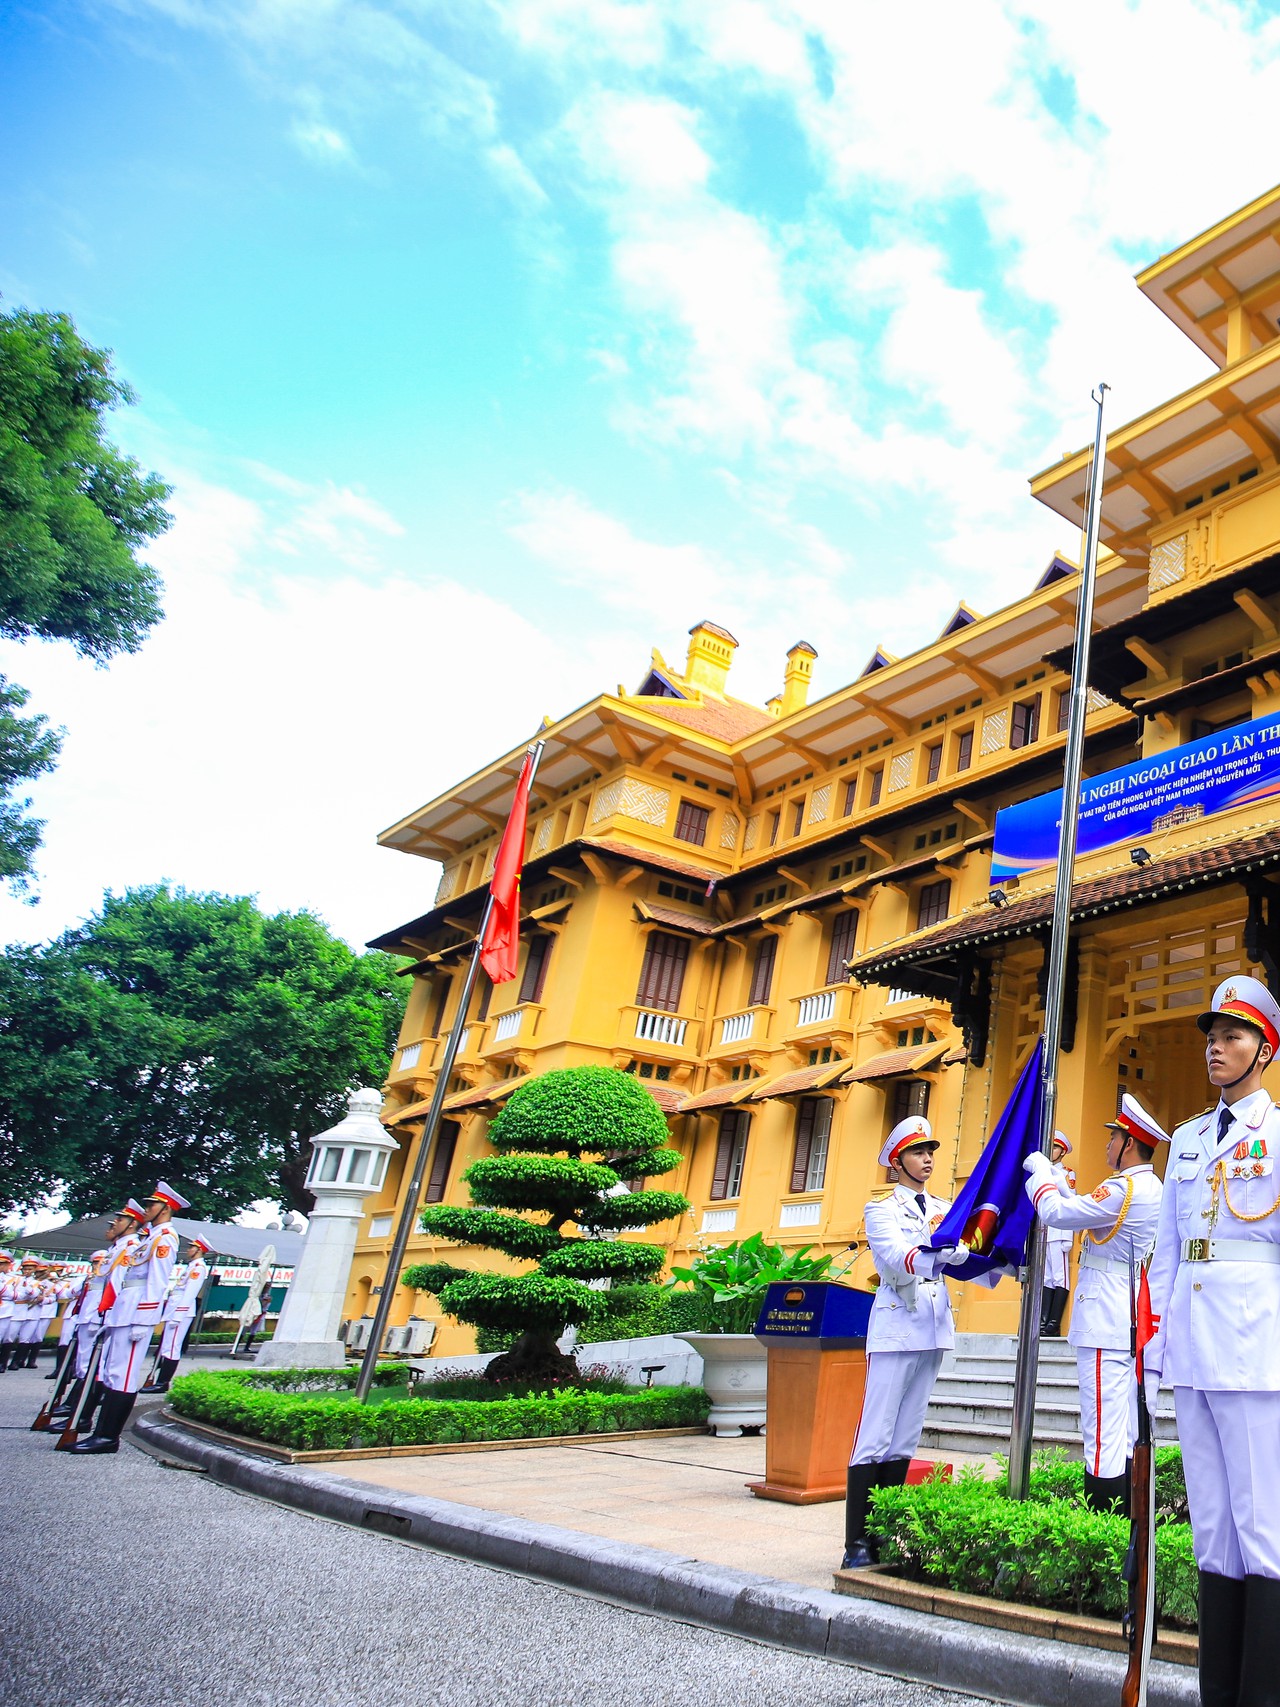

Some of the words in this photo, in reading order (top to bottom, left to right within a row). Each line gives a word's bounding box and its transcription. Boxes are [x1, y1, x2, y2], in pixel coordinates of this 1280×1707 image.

[1084, 809, 1094, 818] VAI
[1095, 803, 1106, 814] TRÒ
[1107, 799, 1121, 810] TIÊN
[1122, 792, 1144, 806] PHONG
[1145, 787, 1154, 797] VÀ
[1154, 782, 1172, 794] THỰC
[1173, 777, 1189, 788] HIỆN
[1190, 769, 1213, 783] NHIỆM
[1214, 765, 1223, 775] VỤ
[1225, 757, 1248, 771] TRỌNG
[1089, 778, 1125, 803] NGHỊ
[1128, 760, 1176, 789] NGOẠI
[1179, 747, 1218, 770] GIAO
[1221, 735, 1255, 757] LẦN
[1104, 811, 1116, 822] CỦA
[1117, 807, 1129, 818] ĐỐI
[1129, 802, 1150, 814] NGOẠI
[1151, 795, 1164, 807] VIỆT
[1165, 791, 1181, 801] NAM
[1182, 782, 1205, 795] TRONG
[1206, 777, 1215, 789] KỲ
[1216, 769, 1244, 785] NGUYÊN
[1245, 764, 1261, 775] MỚI
